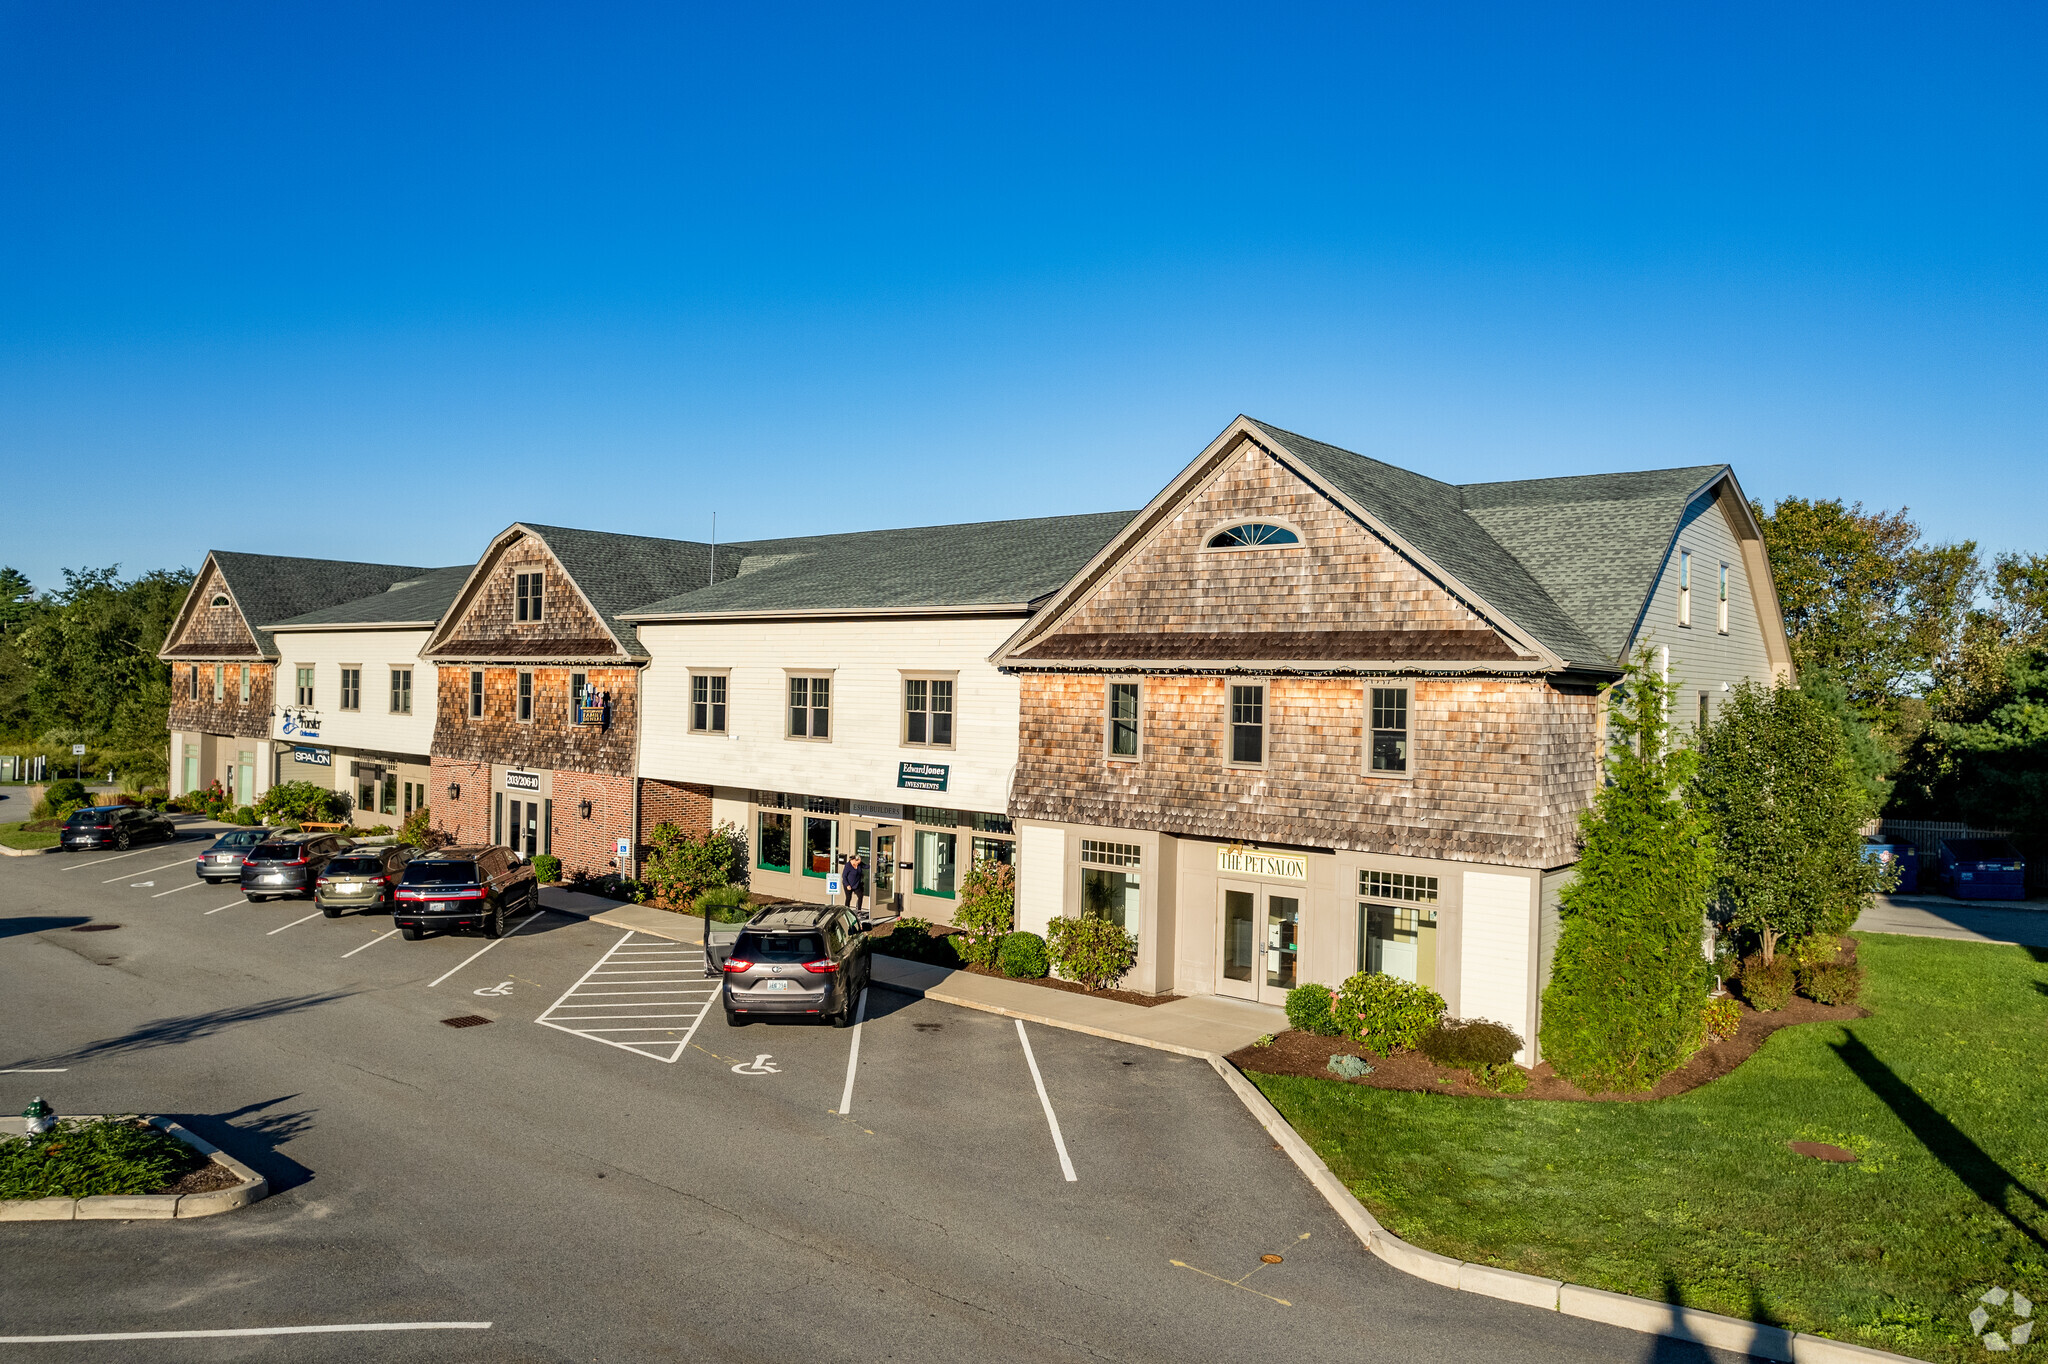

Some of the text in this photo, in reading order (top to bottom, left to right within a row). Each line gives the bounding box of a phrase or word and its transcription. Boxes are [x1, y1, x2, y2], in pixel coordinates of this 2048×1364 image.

[295, 752, 330, 765] SPALON
[905, 781, 939, 790] INVESTMENTS
[869, 805, 900, 815] BUILDERS
[1220, 853, 1304, 877] THE PET SALON
